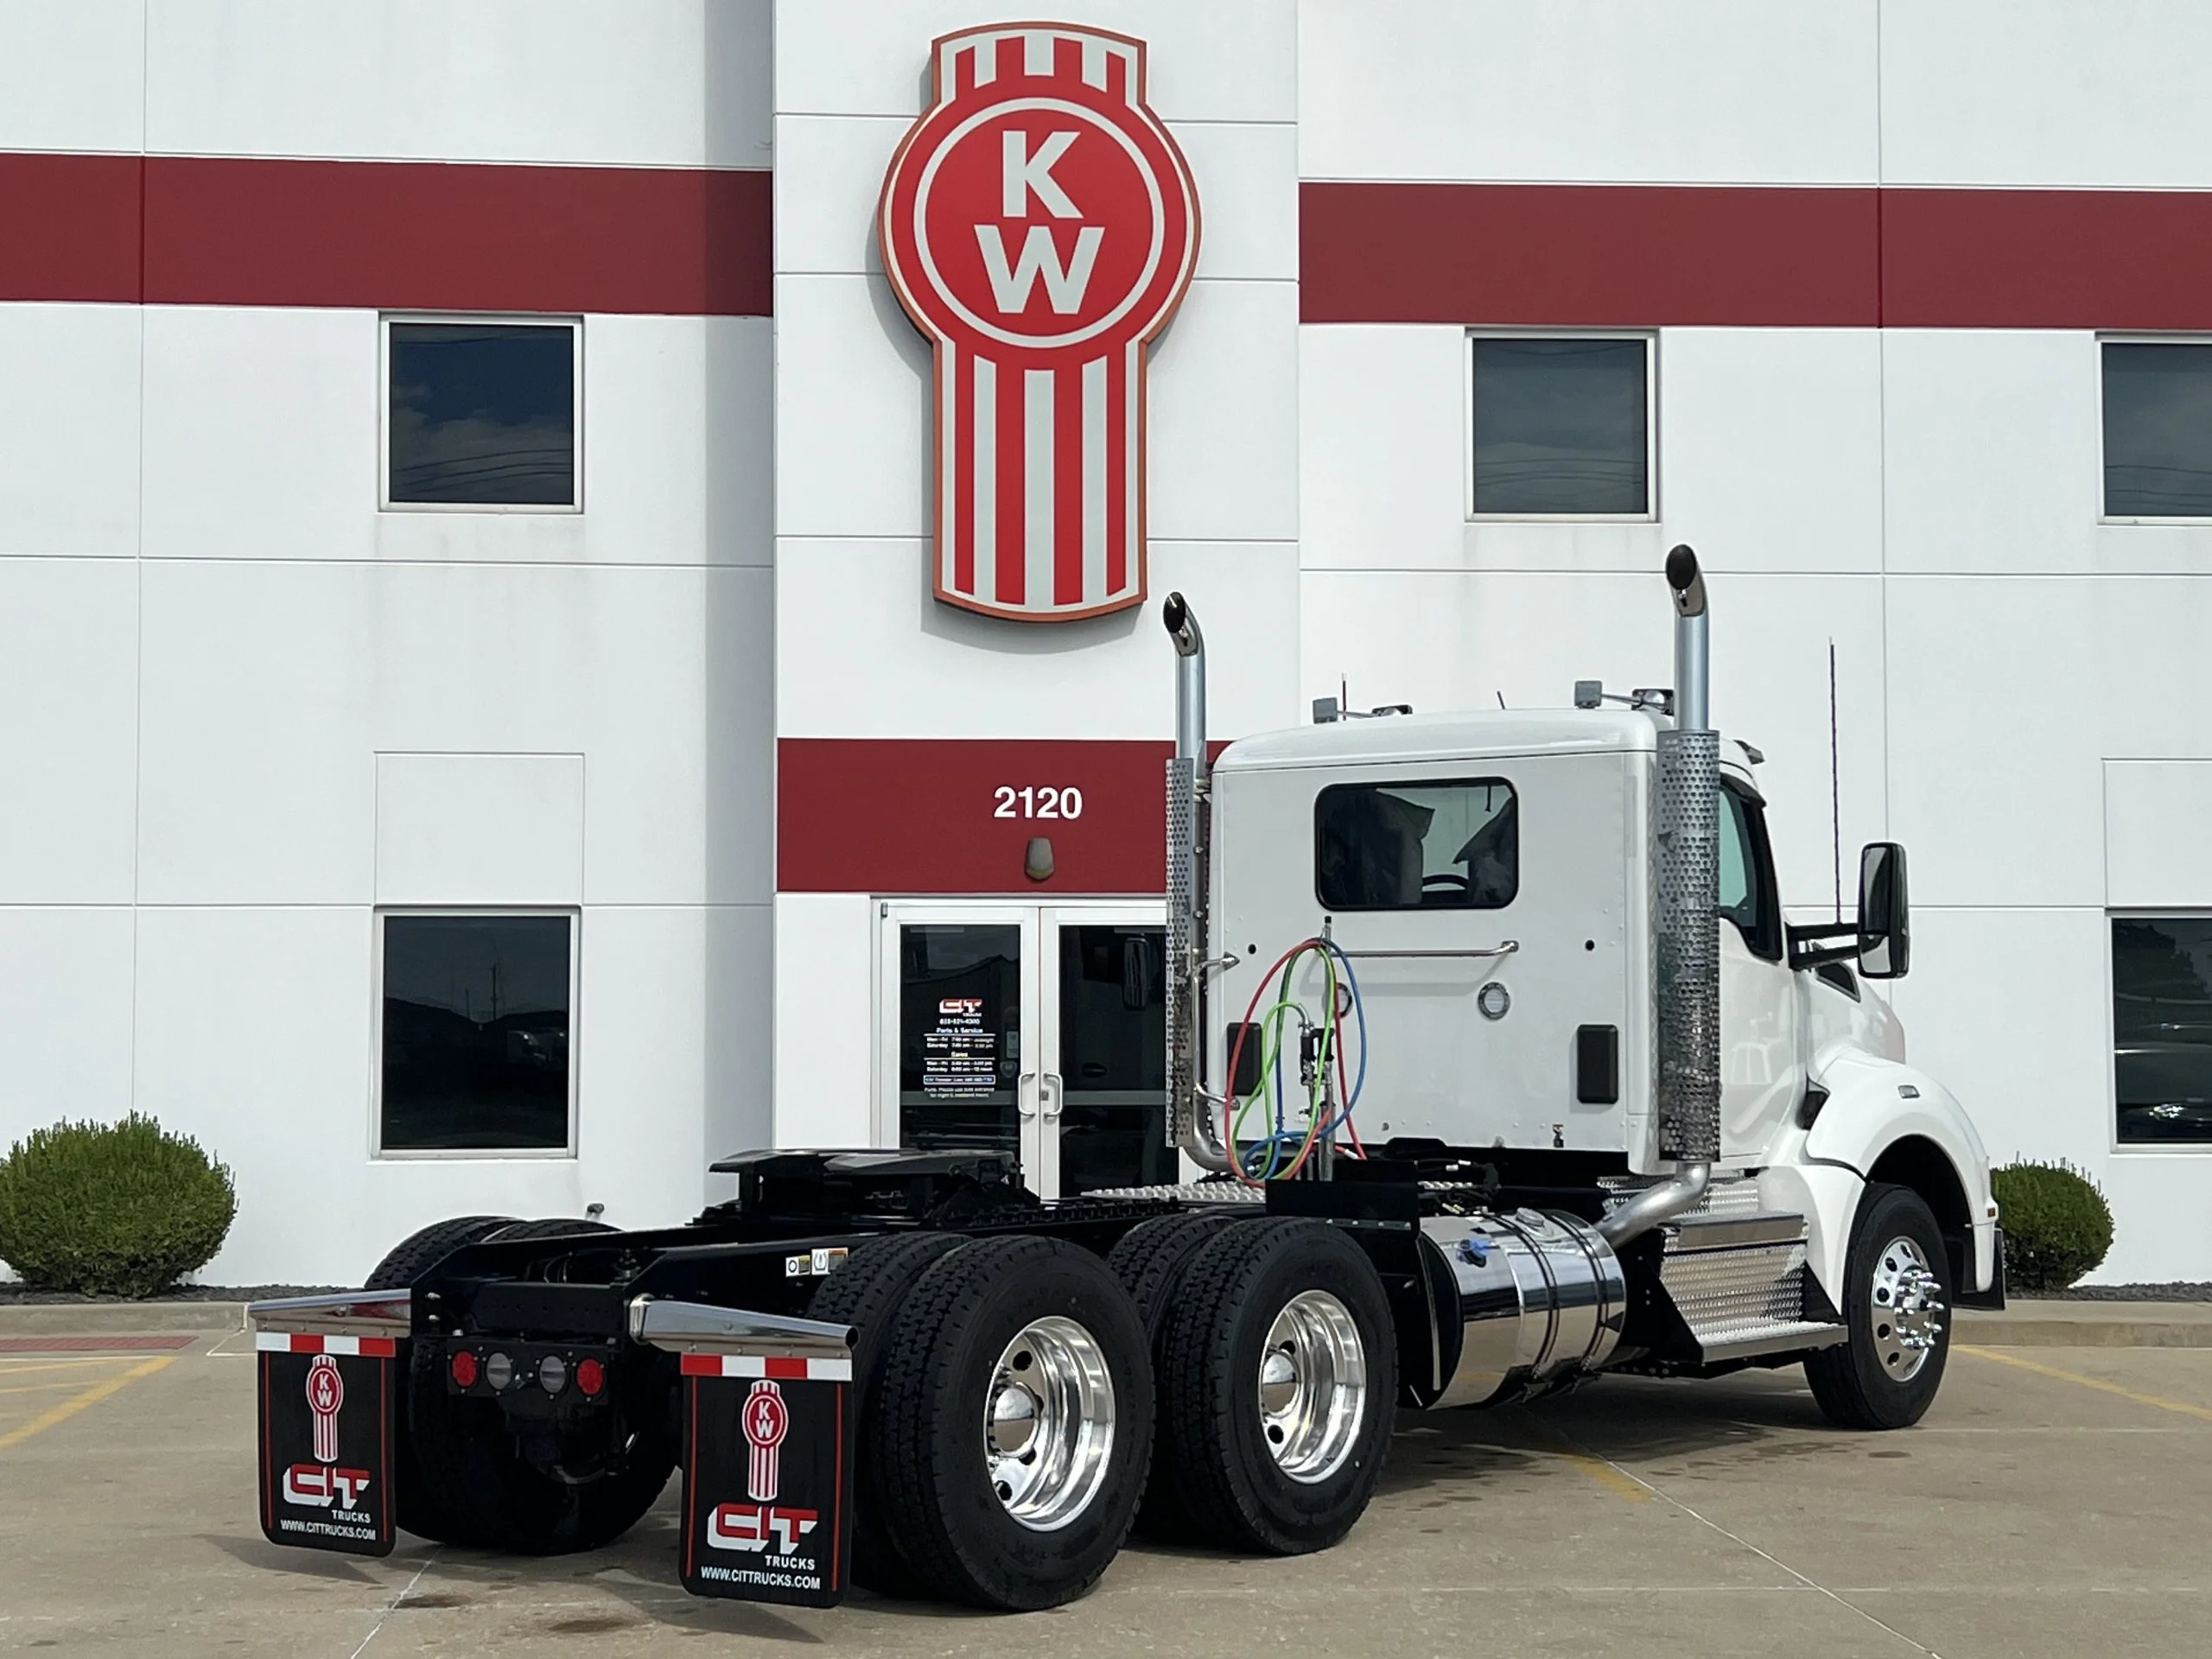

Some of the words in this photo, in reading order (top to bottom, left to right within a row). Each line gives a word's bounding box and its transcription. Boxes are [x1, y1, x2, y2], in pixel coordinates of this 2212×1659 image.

[1001, 130, 1084, 219] K
[974, 224, 1106, 315] W
[994, 785, 1083, 820] 2120
[319, 1373, 330, 1390] K
[317, 1390, 333, 1408] W
[758, 1401, 771, 1420] K
[755, 1420, 775, 1439] W
[283, 1463, 371, 1510] CIT
[331, 1510, 371, 1523] TRUCKS
[280, 1519, 377, 1541] WWW.CITTRUCKS.COM
[707, 1502, 819, 1555] CIT
[765, 1554, 816, 1570] TRUCKS
[701, 1566, 821, 1590] WWW.CITTRUCKS.COM
